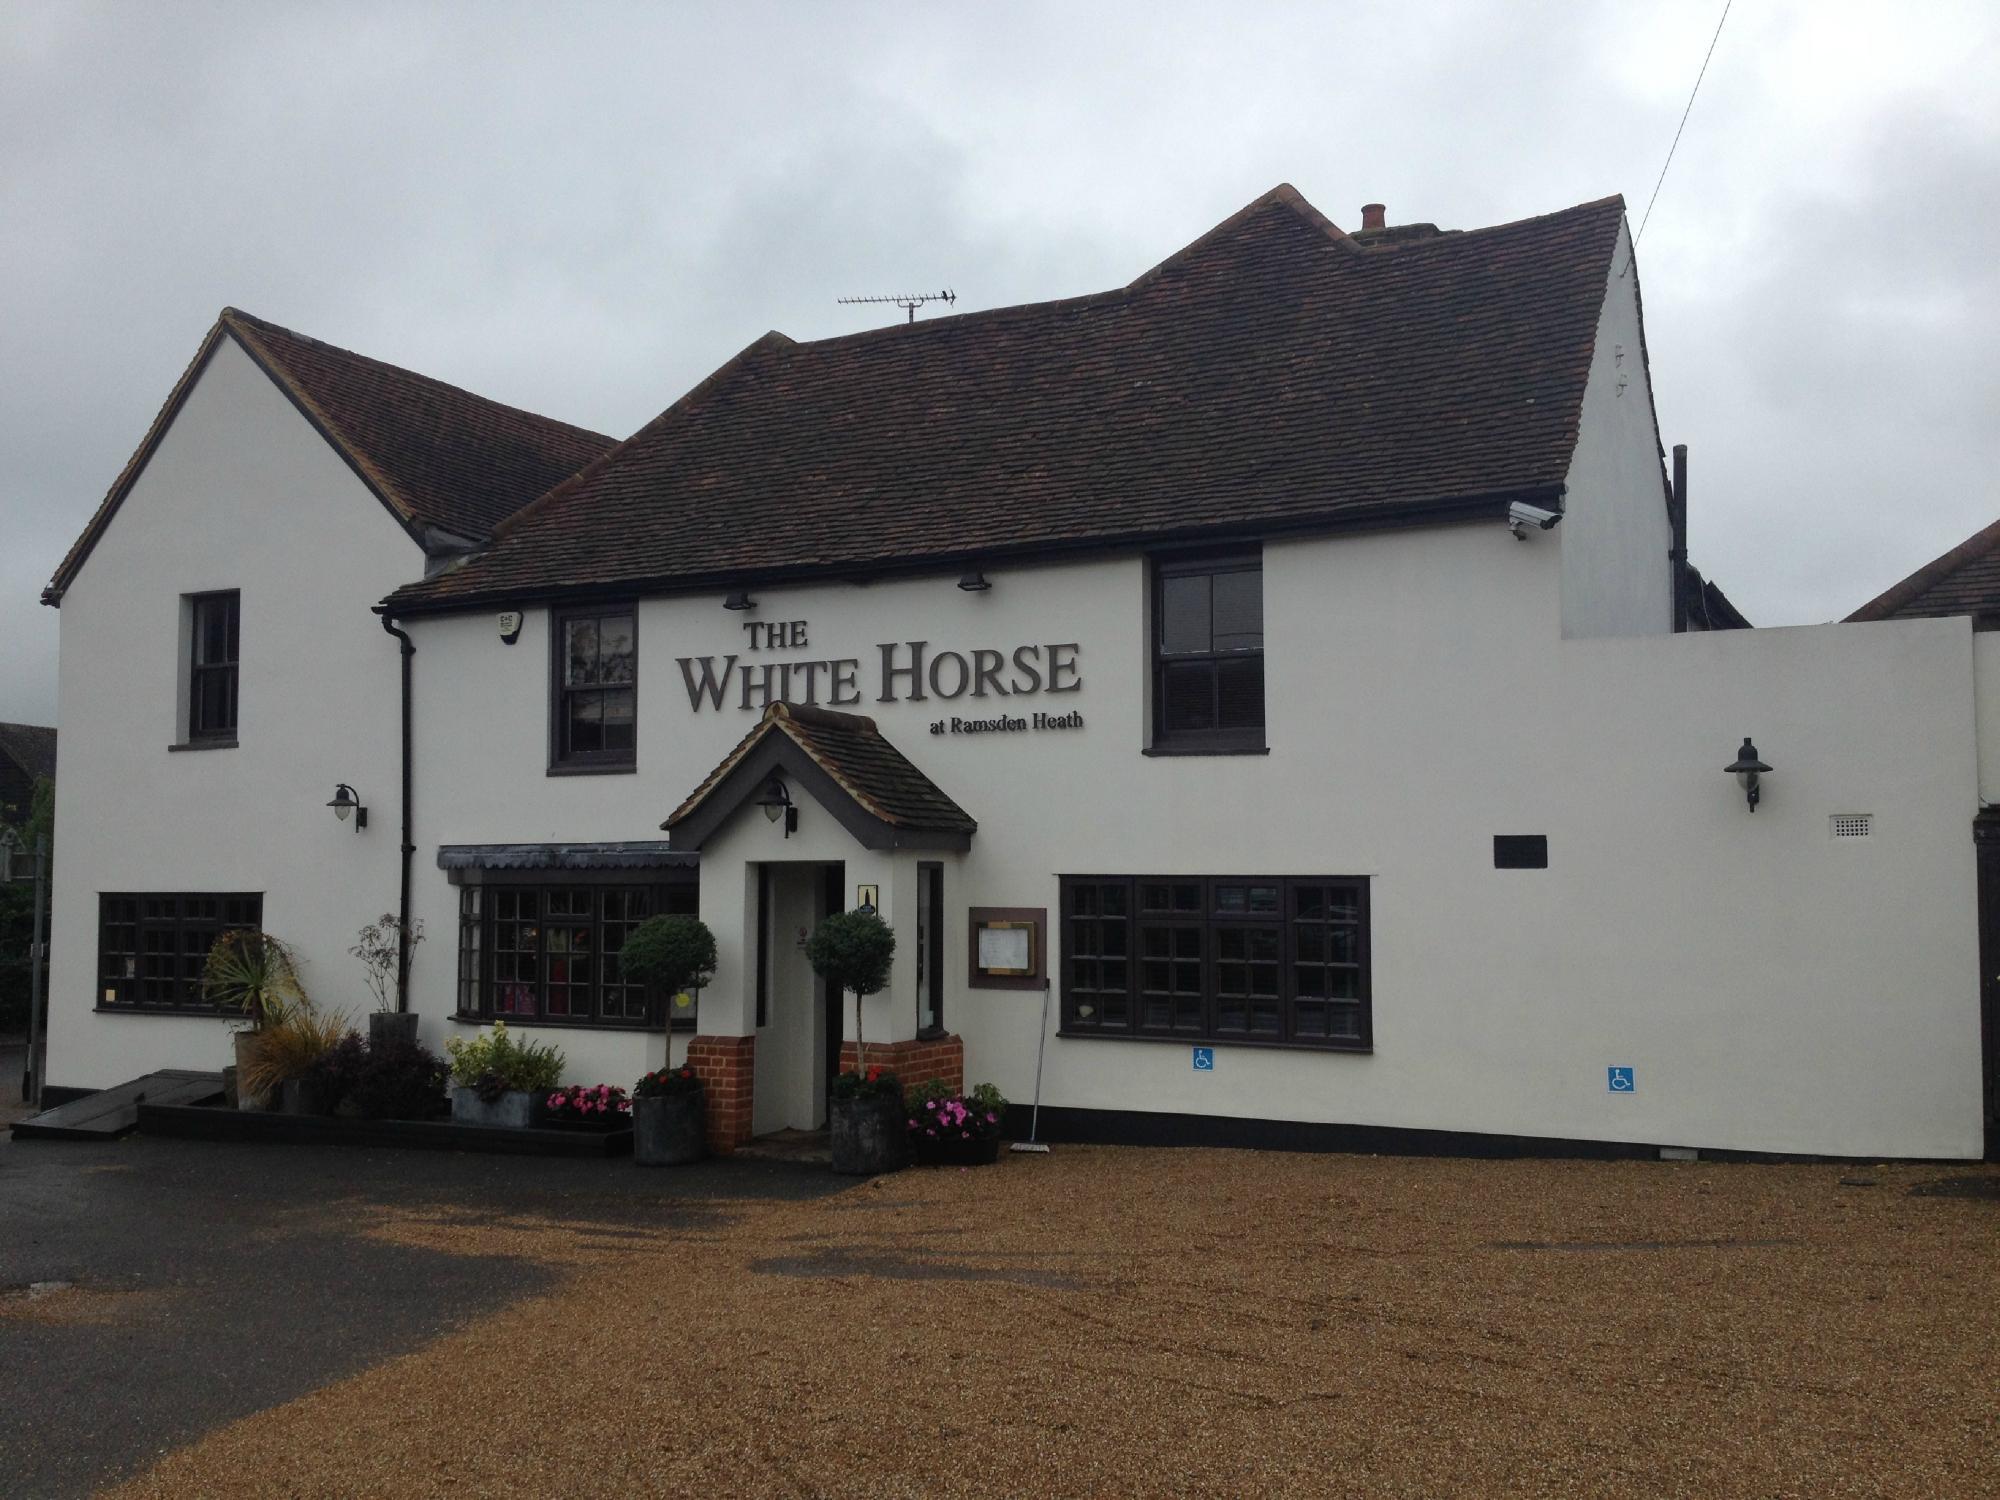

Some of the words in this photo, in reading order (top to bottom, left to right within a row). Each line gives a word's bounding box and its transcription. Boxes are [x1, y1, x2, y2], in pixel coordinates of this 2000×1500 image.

[743, 620, 808, 650] THE
[674, 654, 861, 713] WHITE
[875, 640, 1082, 703] HORSE
[930, 719, 945, 735] at
[950, 713, 1027, 734] Ramsden
[1032, 710, 1084, 730] Heath
